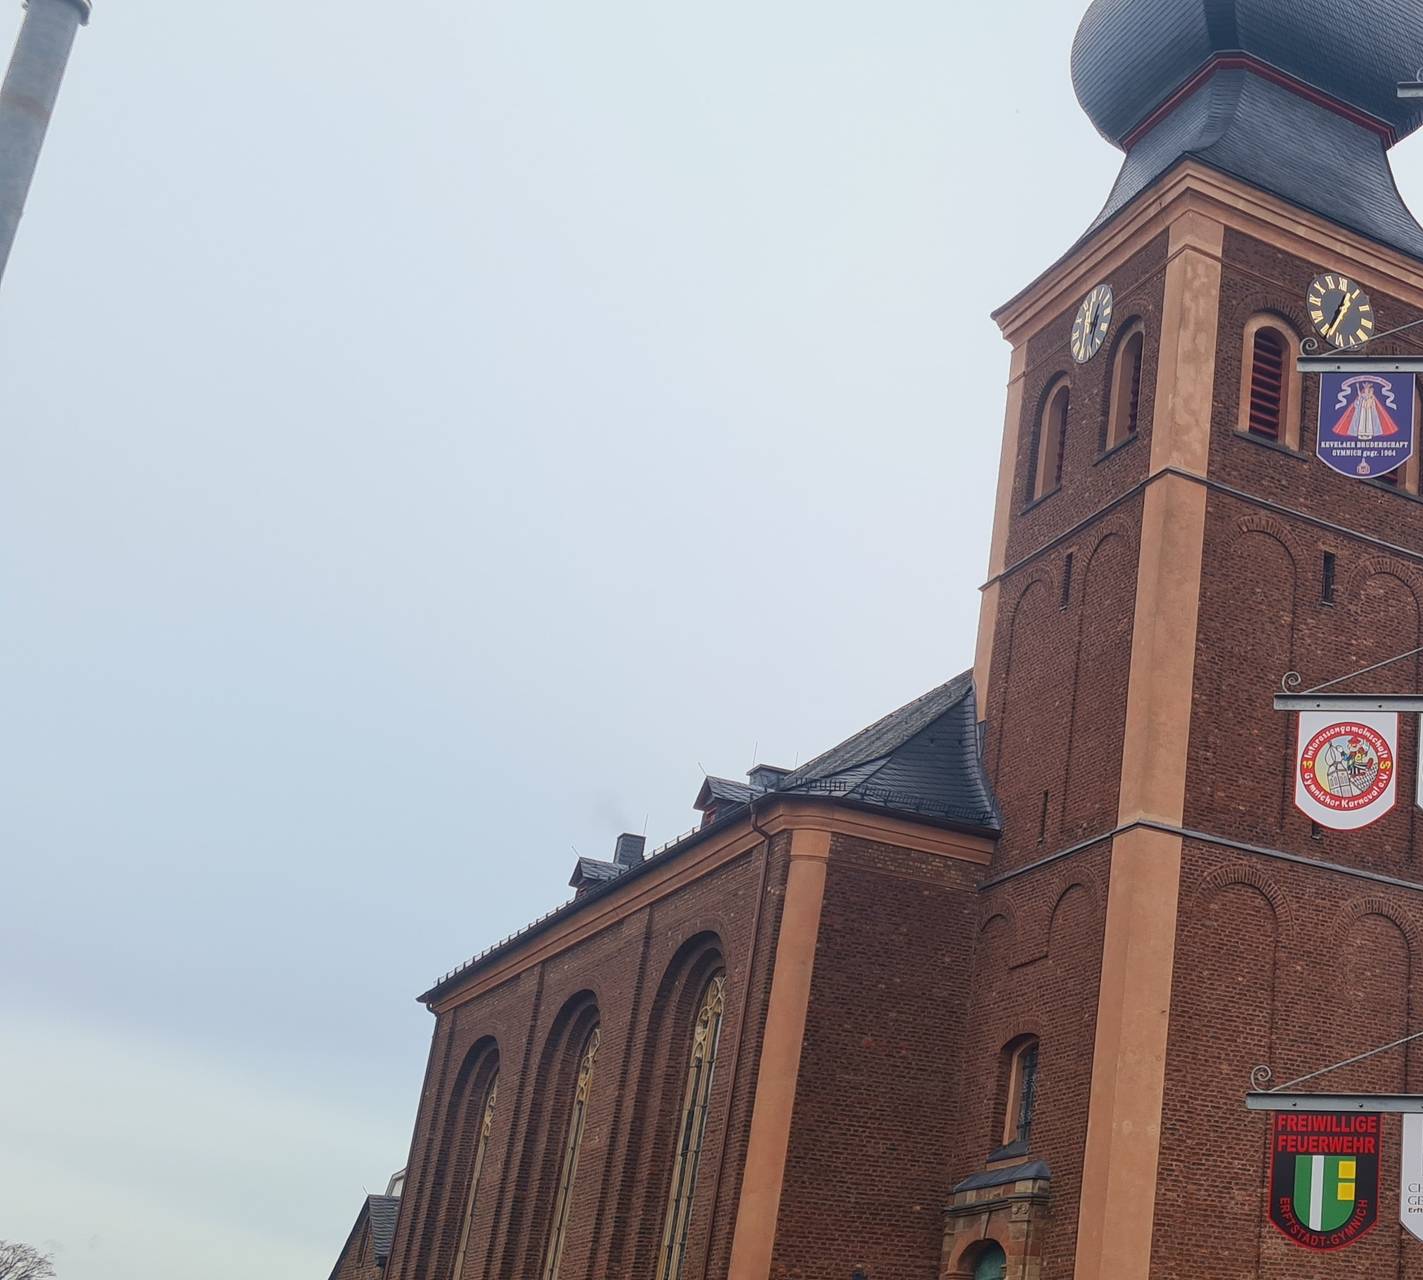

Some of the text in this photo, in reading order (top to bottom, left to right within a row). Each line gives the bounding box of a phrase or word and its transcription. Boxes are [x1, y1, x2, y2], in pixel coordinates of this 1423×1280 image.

[1304, 725, 1388, 759] Interessengemeinschaft
[1304, 772, 1340, 807] Gymnicher
[1341, 787, 1380, 808] Karneval
[1278, 1114, 1377, 1133] FREIWILLIGE
[1277, 1135, 1375, 1154] FEUERWEHR
